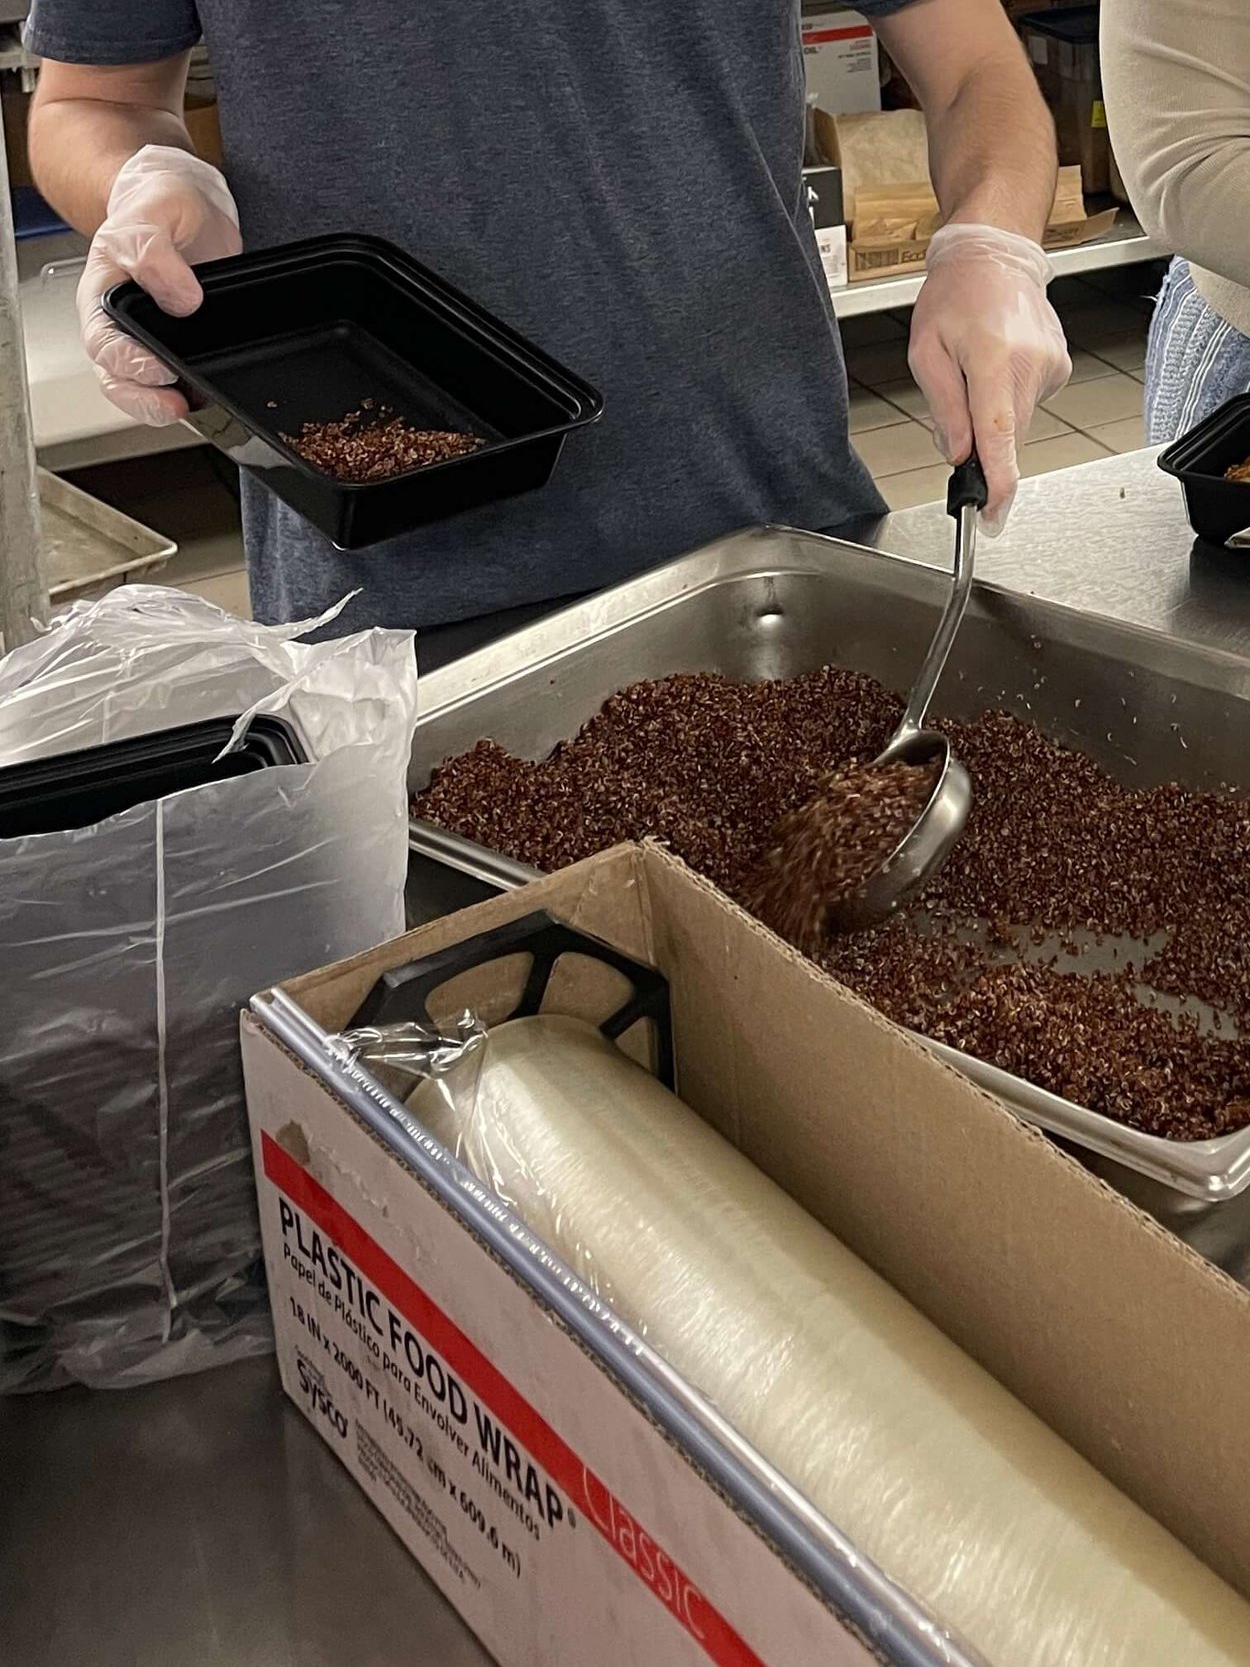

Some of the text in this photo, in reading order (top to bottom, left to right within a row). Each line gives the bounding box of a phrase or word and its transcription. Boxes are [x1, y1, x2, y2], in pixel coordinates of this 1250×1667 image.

[278, 1196, 384, 1337] PLASTIC
[388, 1308, 468, 1425] FOOD
[283, 1242, 541, 1542] Papel de Plástico para Envolver Alimentos
[290, 1296, 305, 1325] 18
[307, 1313, 322, 1344] IN
[333, 1343, 364, 1390] 2000
[366, 1380, 380, 1410] FT
[460, 1490, 499, 1551] 609.6
[296, 1358, 348, 1439] Sysco
[583, 1465, 705, 1640] Classic
